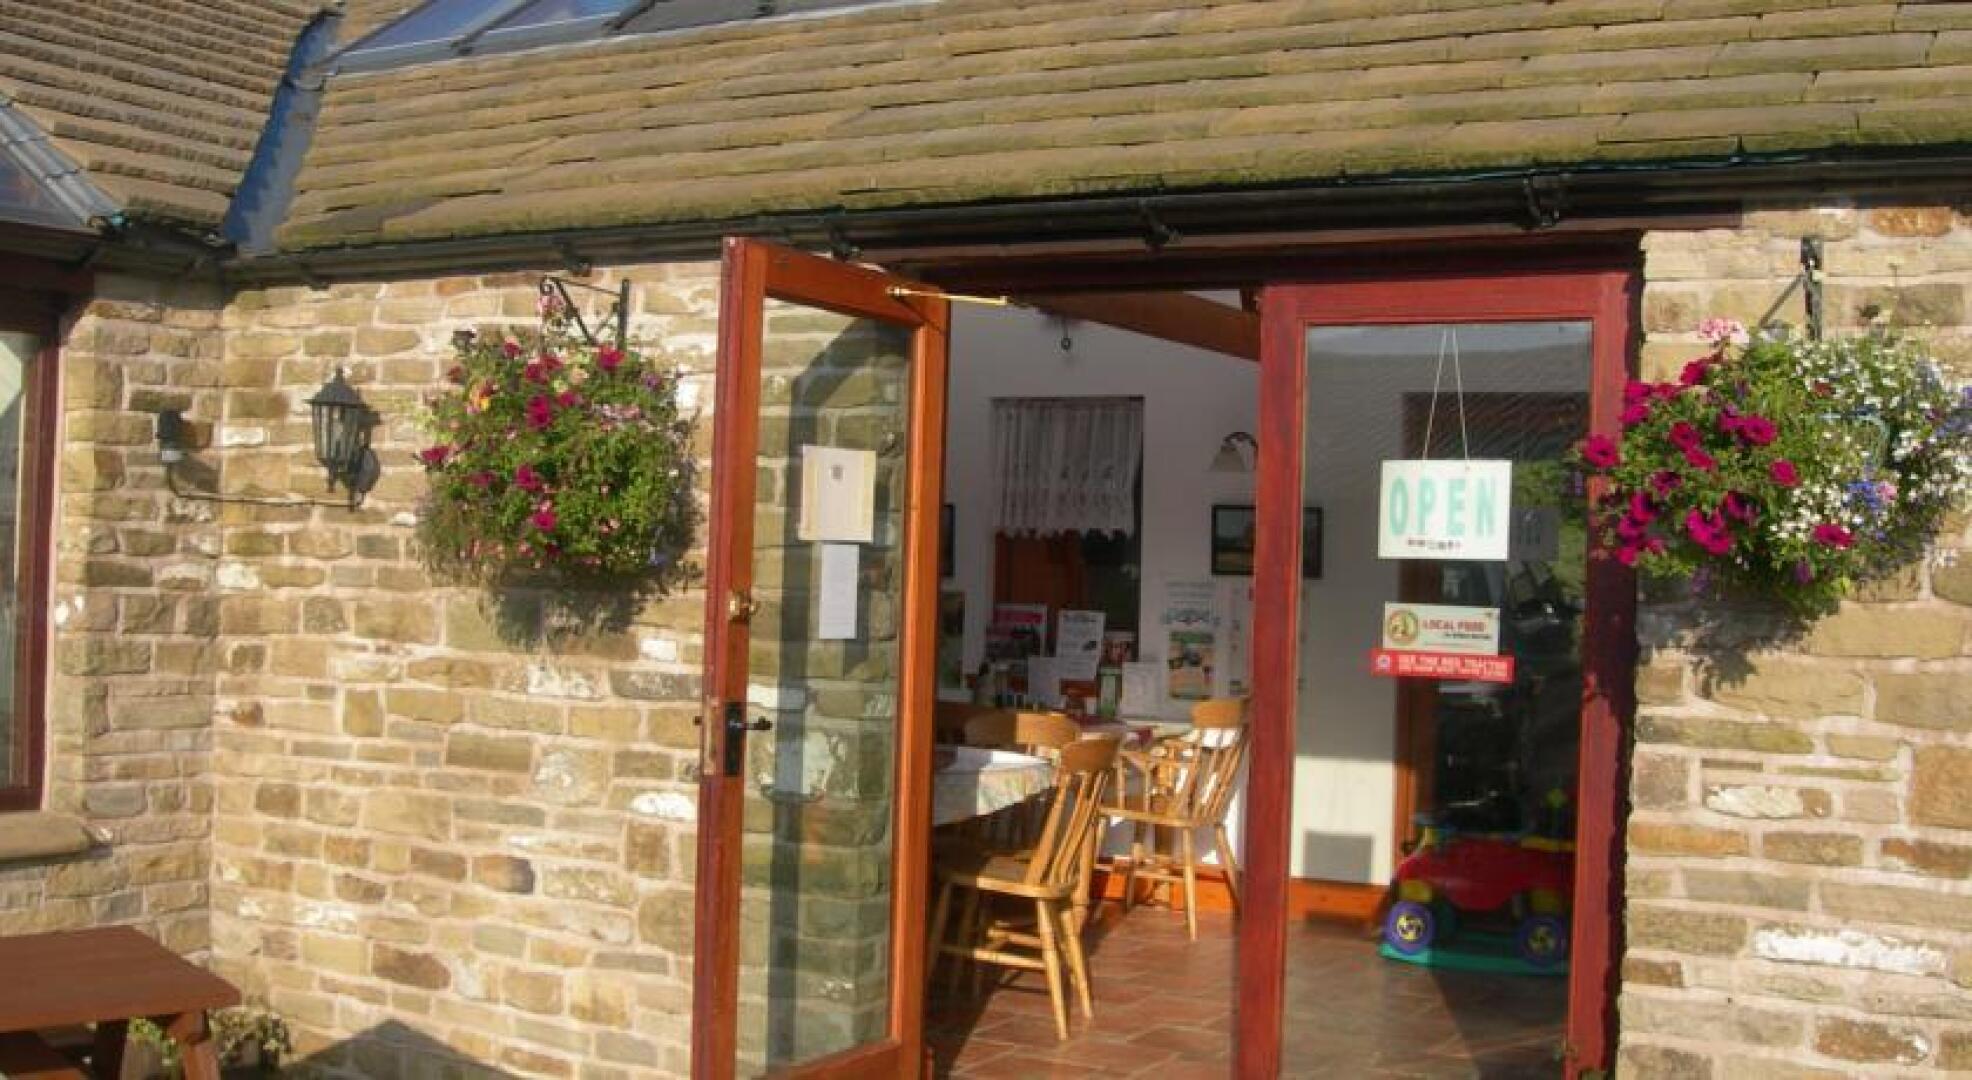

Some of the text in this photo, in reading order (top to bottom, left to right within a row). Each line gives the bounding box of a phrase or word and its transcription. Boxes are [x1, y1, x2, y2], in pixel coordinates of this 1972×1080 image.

[1390, 477, 1496, 536] OPEN
[1422, 619, 1485, 632] LOCAL FOOD
